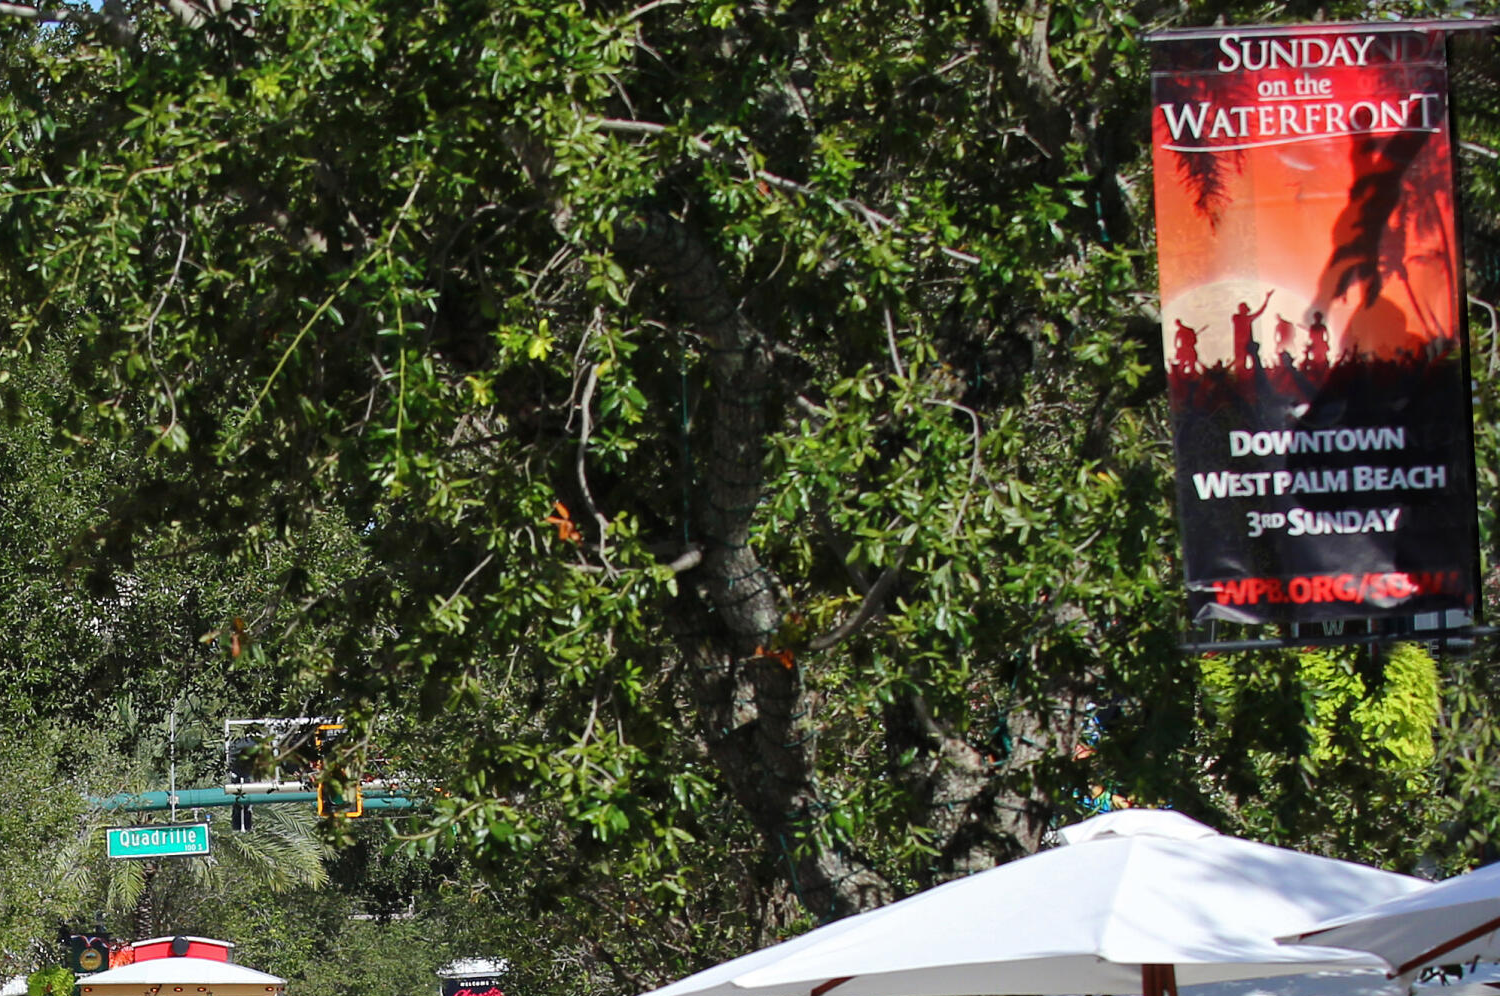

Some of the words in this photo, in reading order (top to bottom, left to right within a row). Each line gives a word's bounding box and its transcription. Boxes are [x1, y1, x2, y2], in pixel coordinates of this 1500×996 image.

[1218, 33, 1375, 72] SUNDAY
[1258, 77, 1286, 95] on
[1295, 72, 1332, 94] the
[1161, 93, 1439, 140] WATERFRONT
[1229, 427, 1405, 457] DOWNTOWN
[1193, 471, 1270, 500] WEST
[1273, 469, 1348, 496] PALM
[1353, 465, 1446, 491] BEACH
[1246, 511, 1286, 537] 3RD
[1287, 507, 1400, 536] SUNDAY
[120, 829, 196, 848] Quadrille
